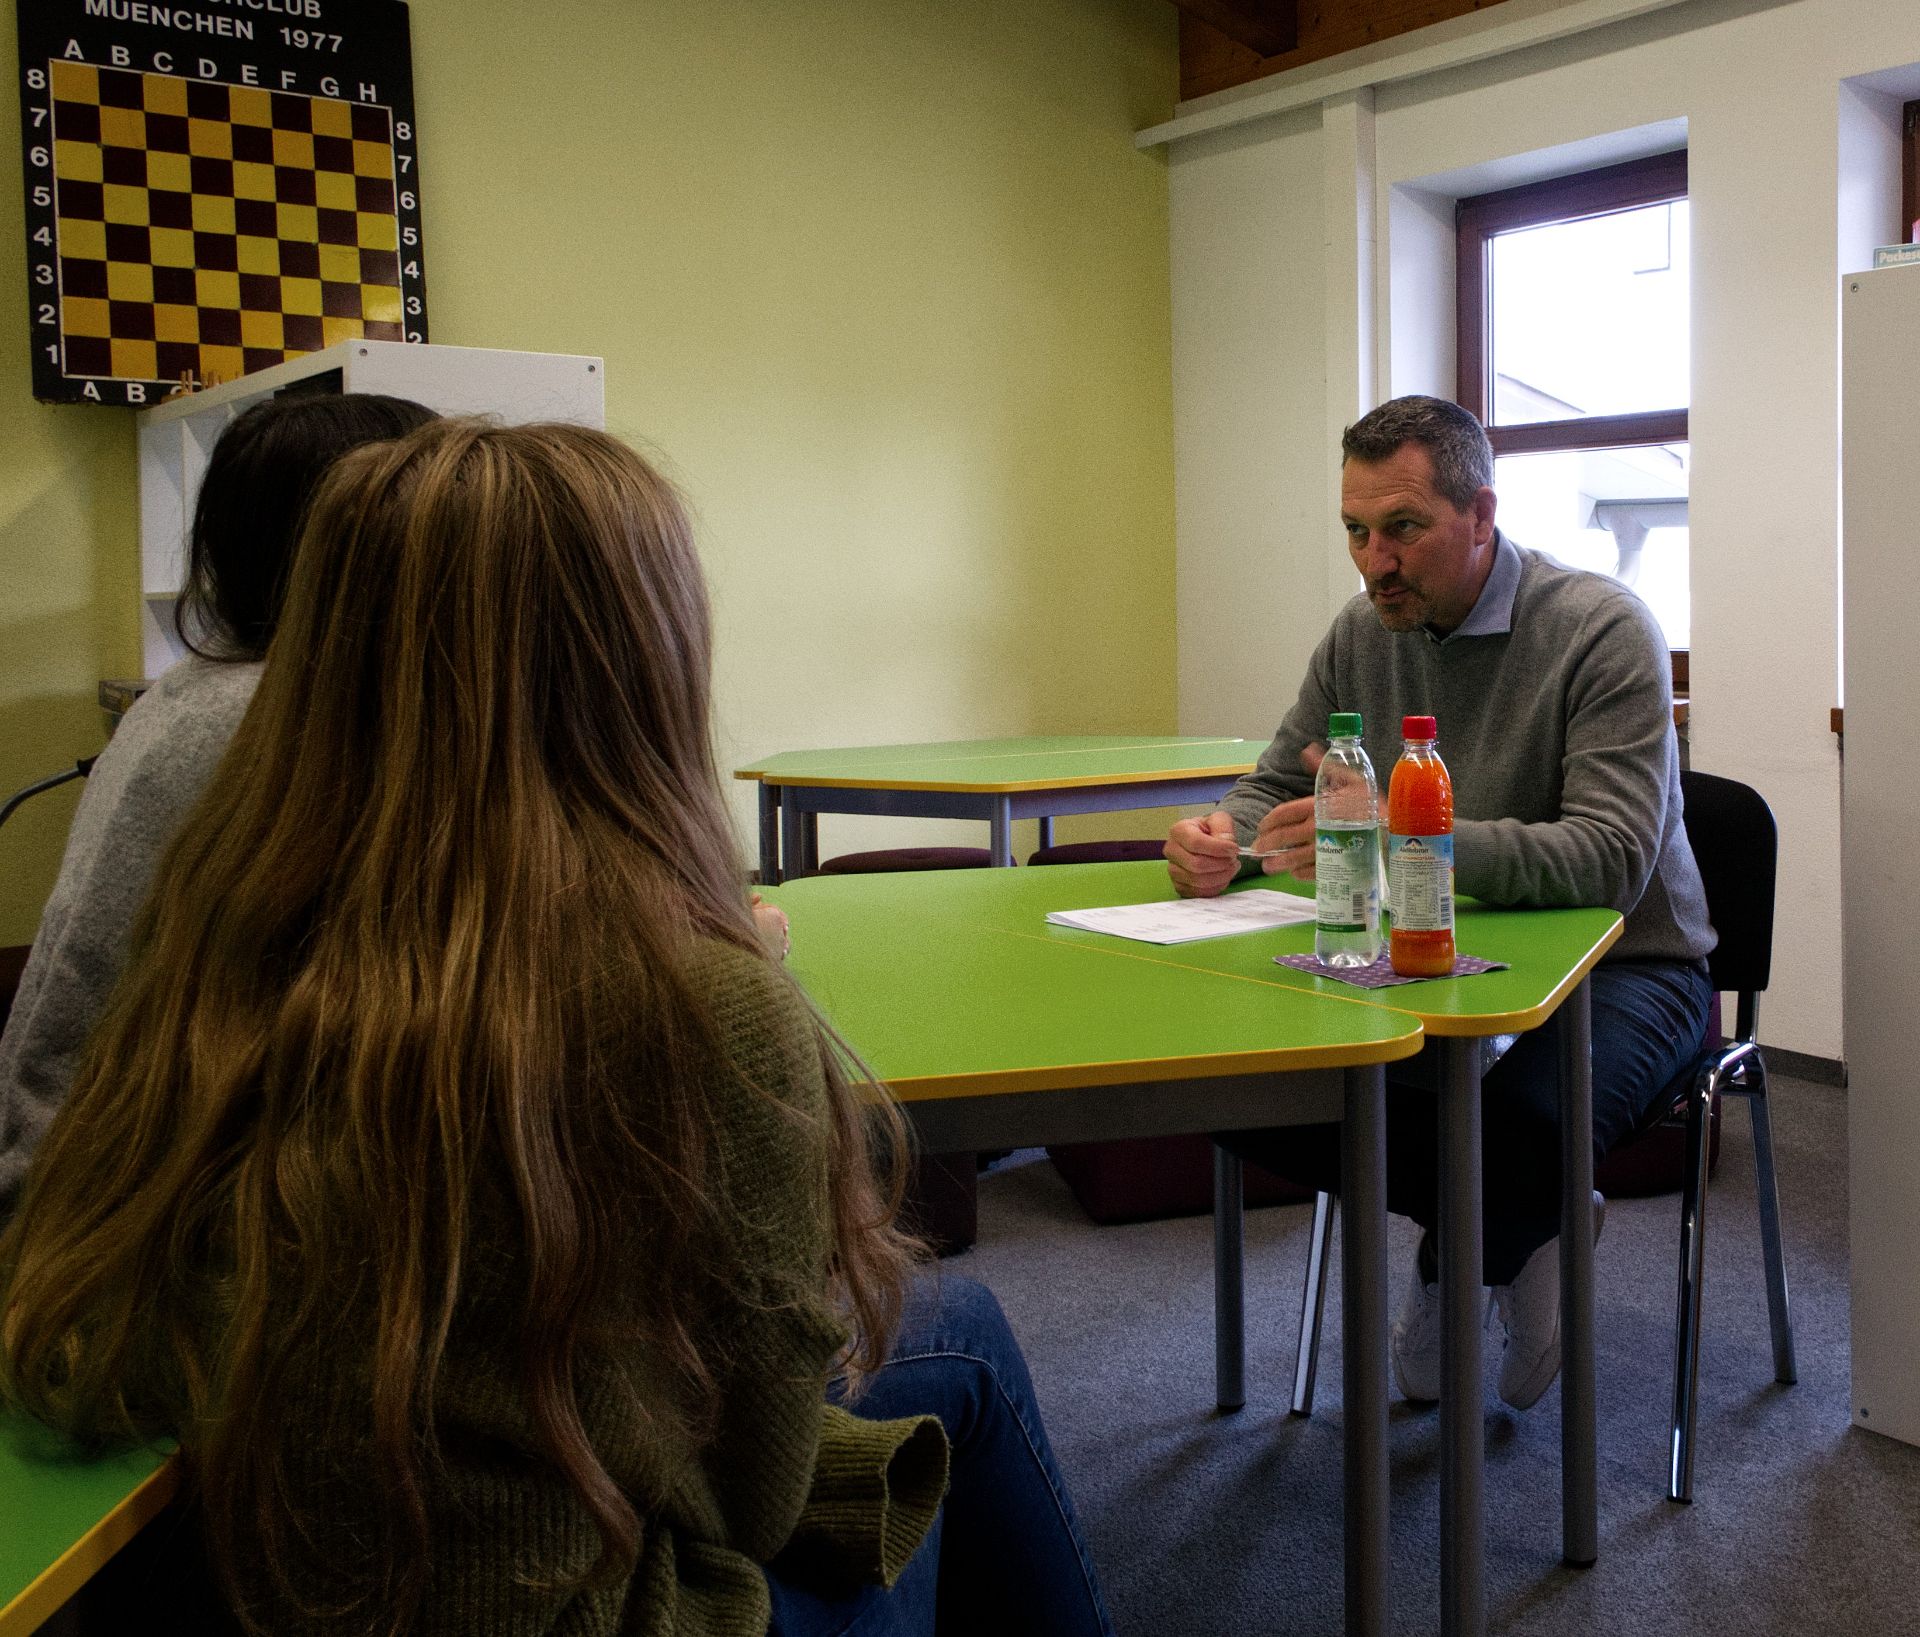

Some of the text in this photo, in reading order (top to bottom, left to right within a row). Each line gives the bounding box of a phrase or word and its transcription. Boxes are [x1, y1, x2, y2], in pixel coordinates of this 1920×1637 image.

[85, 0, 343, 53] MUENCHEN 1977
[27, 69, 46, 88] 8
[64, 39, 377, 102] A B C D E F G H
[30, 107, 47, 127] 7
[396, 121, 412, 140] 8
[30, 147, 49, 167] 6
[397, 155, 411, 173] 7
[33, 187, 50, 206] 5
[400, 192, 416, 210] 6
[33, 226, 53, 246] 4
[402, 227, 418, 245] 5
[36, 265, 54, 285] 3
[404, 261, 420, 279] 4
[38, 305, 56, 325] 2
[406, 297, 422, 315] 3
[45, 344, 58, 364] 1
[83, 381, 102, 401] A
[126, 382, 146, 403] B
